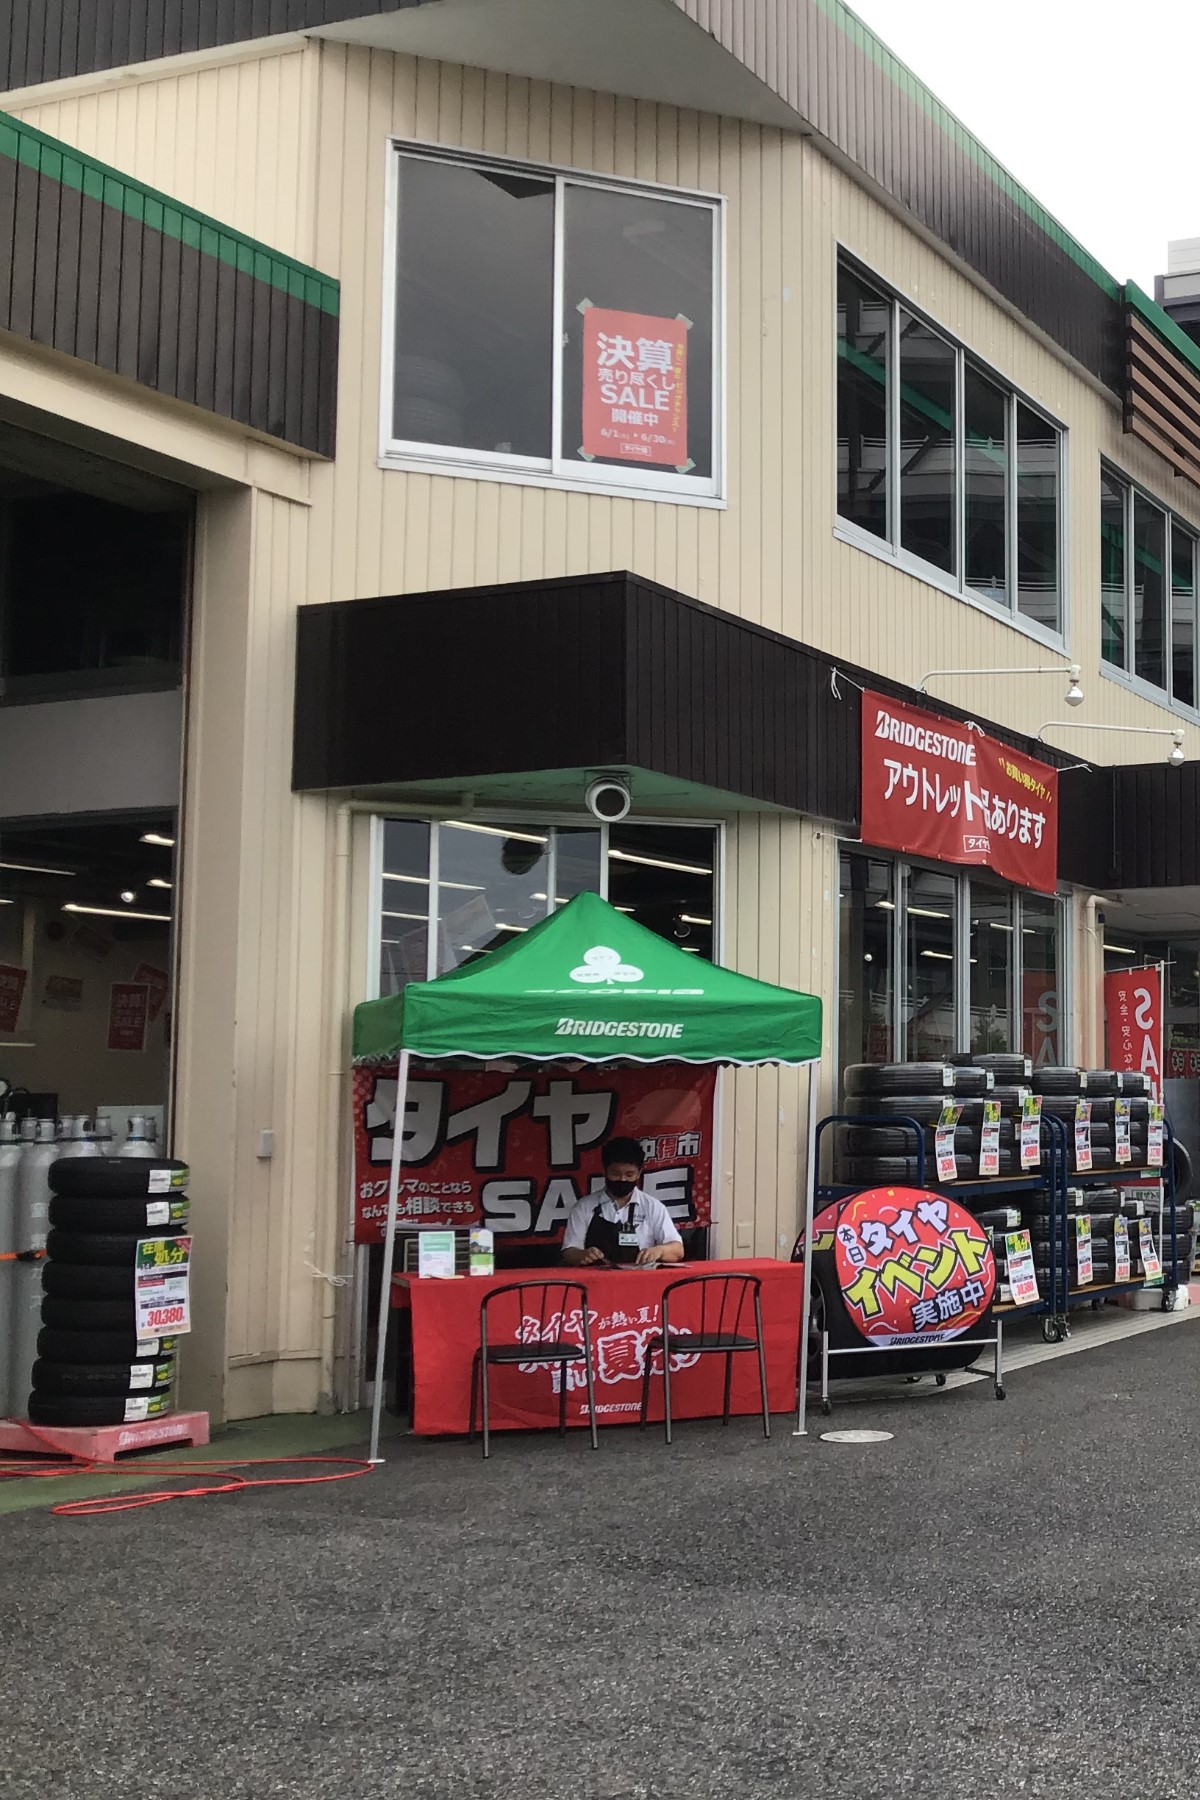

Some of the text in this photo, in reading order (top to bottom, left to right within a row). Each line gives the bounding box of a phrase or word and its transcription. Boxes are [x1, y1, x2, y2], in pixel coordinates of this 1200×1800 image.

[597, 332, 674, 374] 決算
[598, 368, 675, 390] 売り尽くし
[601, 384, 670, 411] SALE
[611, 408, 659, 426] 開催中
[875, 710, 976, 766] BRIDGESTONE
[555, 1018, 684, 1039] BRIDGESTONE
[367, 1078, 613, 1168] タイヤ
[483, 1168, 690, 1233] SAE
[839, 1227, 865, 1264] 本日
[861, 1200, 948, 1256] タイヤ
[845, 1231, 988, 1316] イベント
[911, 1279, 985, 1331] 実施中
